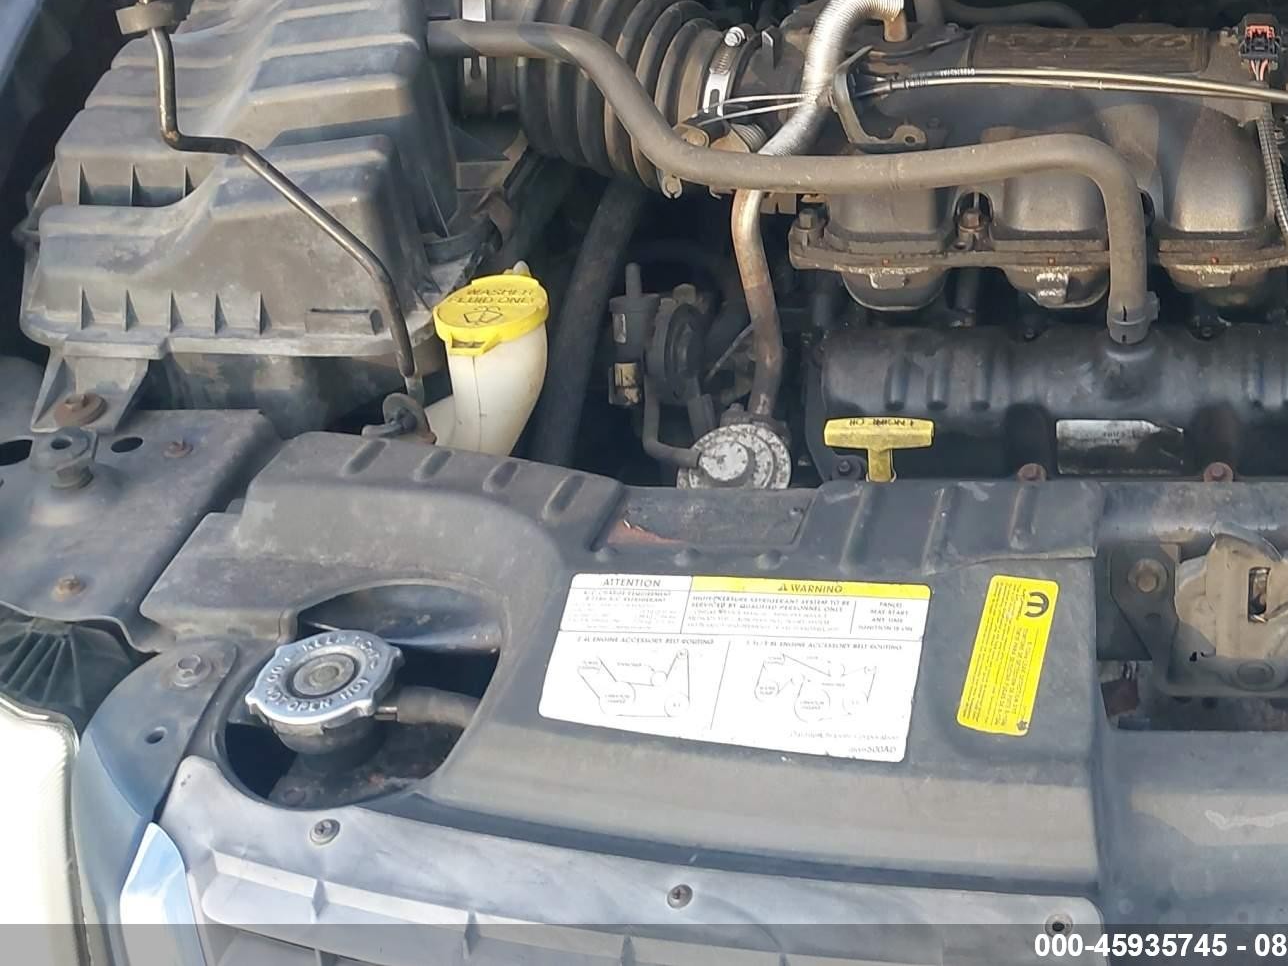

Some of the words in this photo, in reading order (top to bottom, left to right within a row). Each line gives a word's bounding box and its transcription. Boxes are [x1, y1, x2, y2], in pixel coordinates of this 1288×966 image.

[466, 288, 533, 296] WASHER
[602, 578, 662, 587] ATTENTION
[790, 585, 843, 594] WARNING
